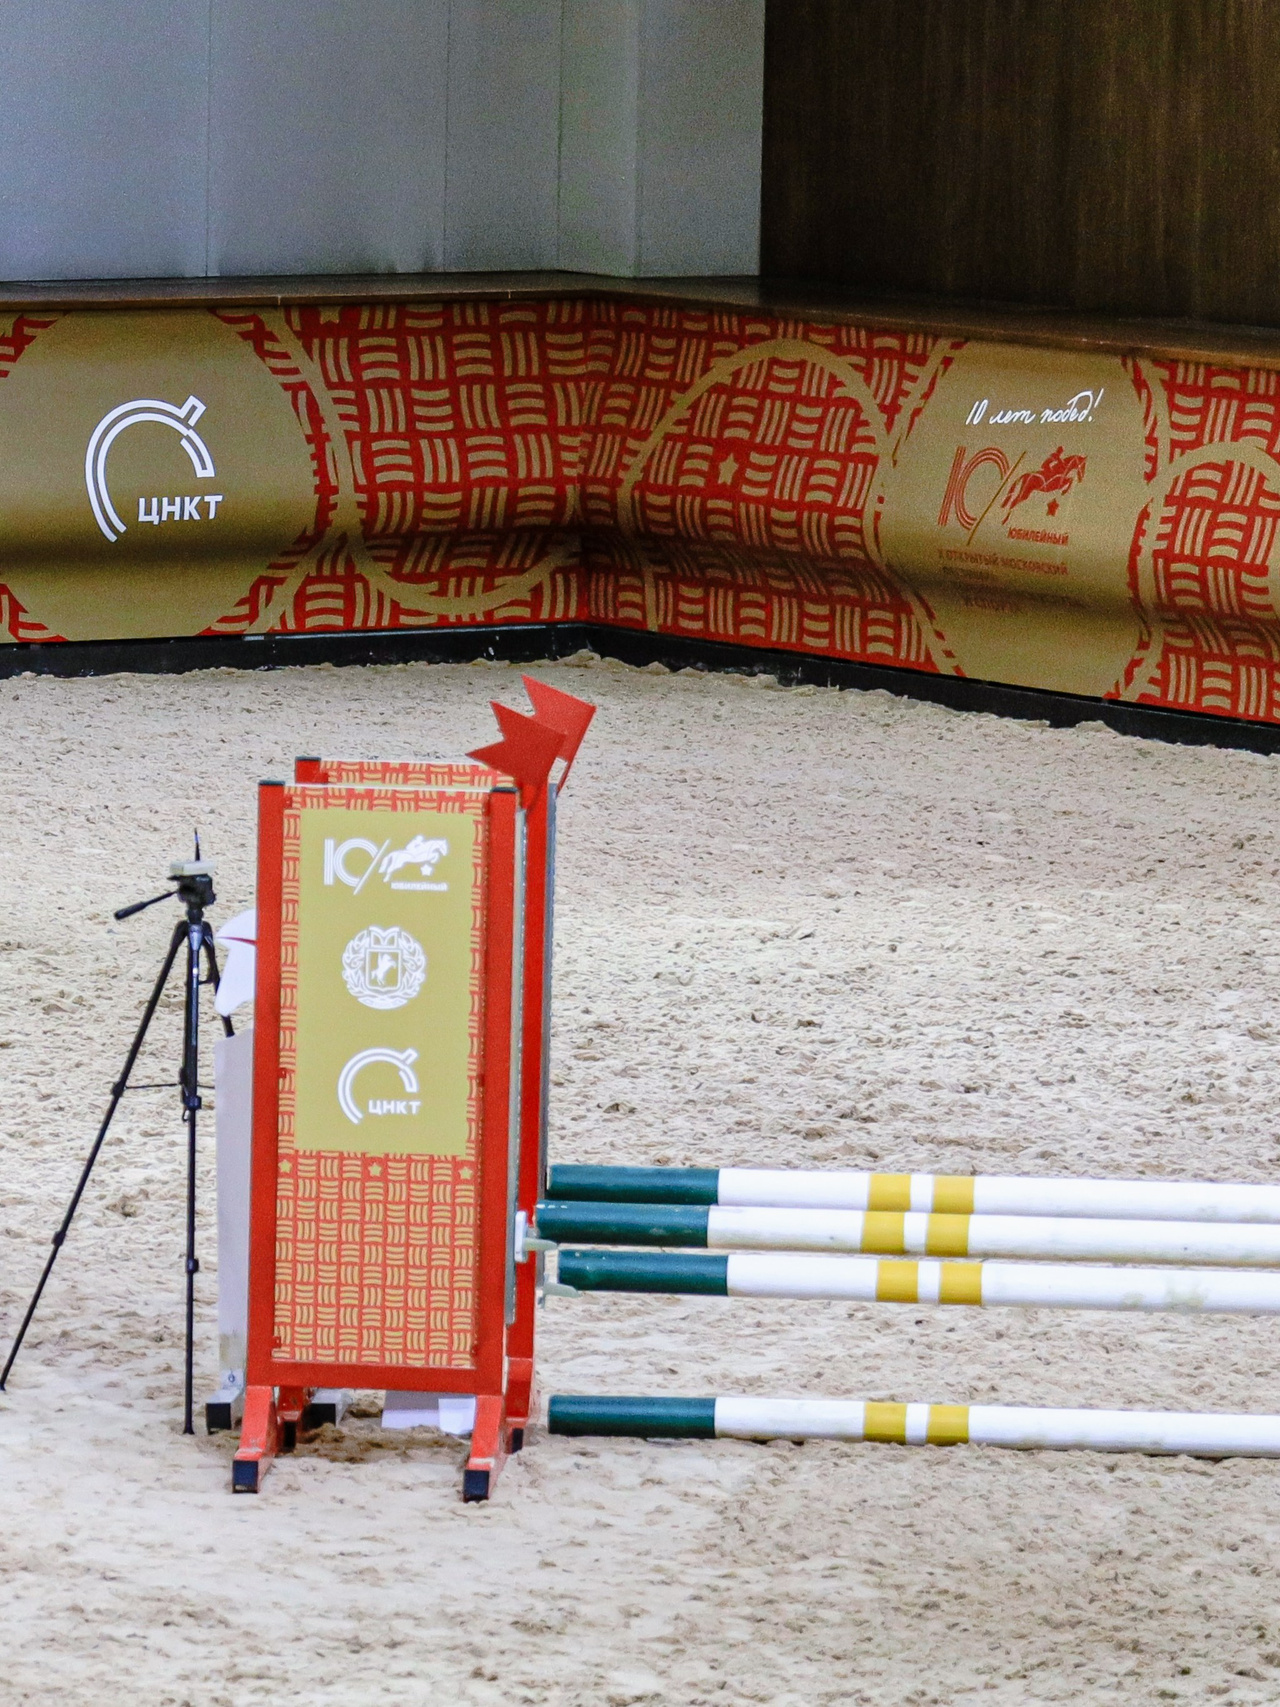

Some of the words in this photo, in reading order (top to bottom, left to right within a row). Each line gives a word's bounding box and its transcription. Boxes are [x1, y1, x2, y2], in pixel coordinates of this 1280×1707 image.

[965, 399, 989, 426] 10
[989, 411, 1037, 425] лет
[1040, 388, 1104, 425] побед!
[137, 494, 224, 526] ЦНКТ
[1007, 526, 1069, 546] ЮБИЛЕЙНЫЙ
[367, 1099, 422, 1116] ЦНКТ
